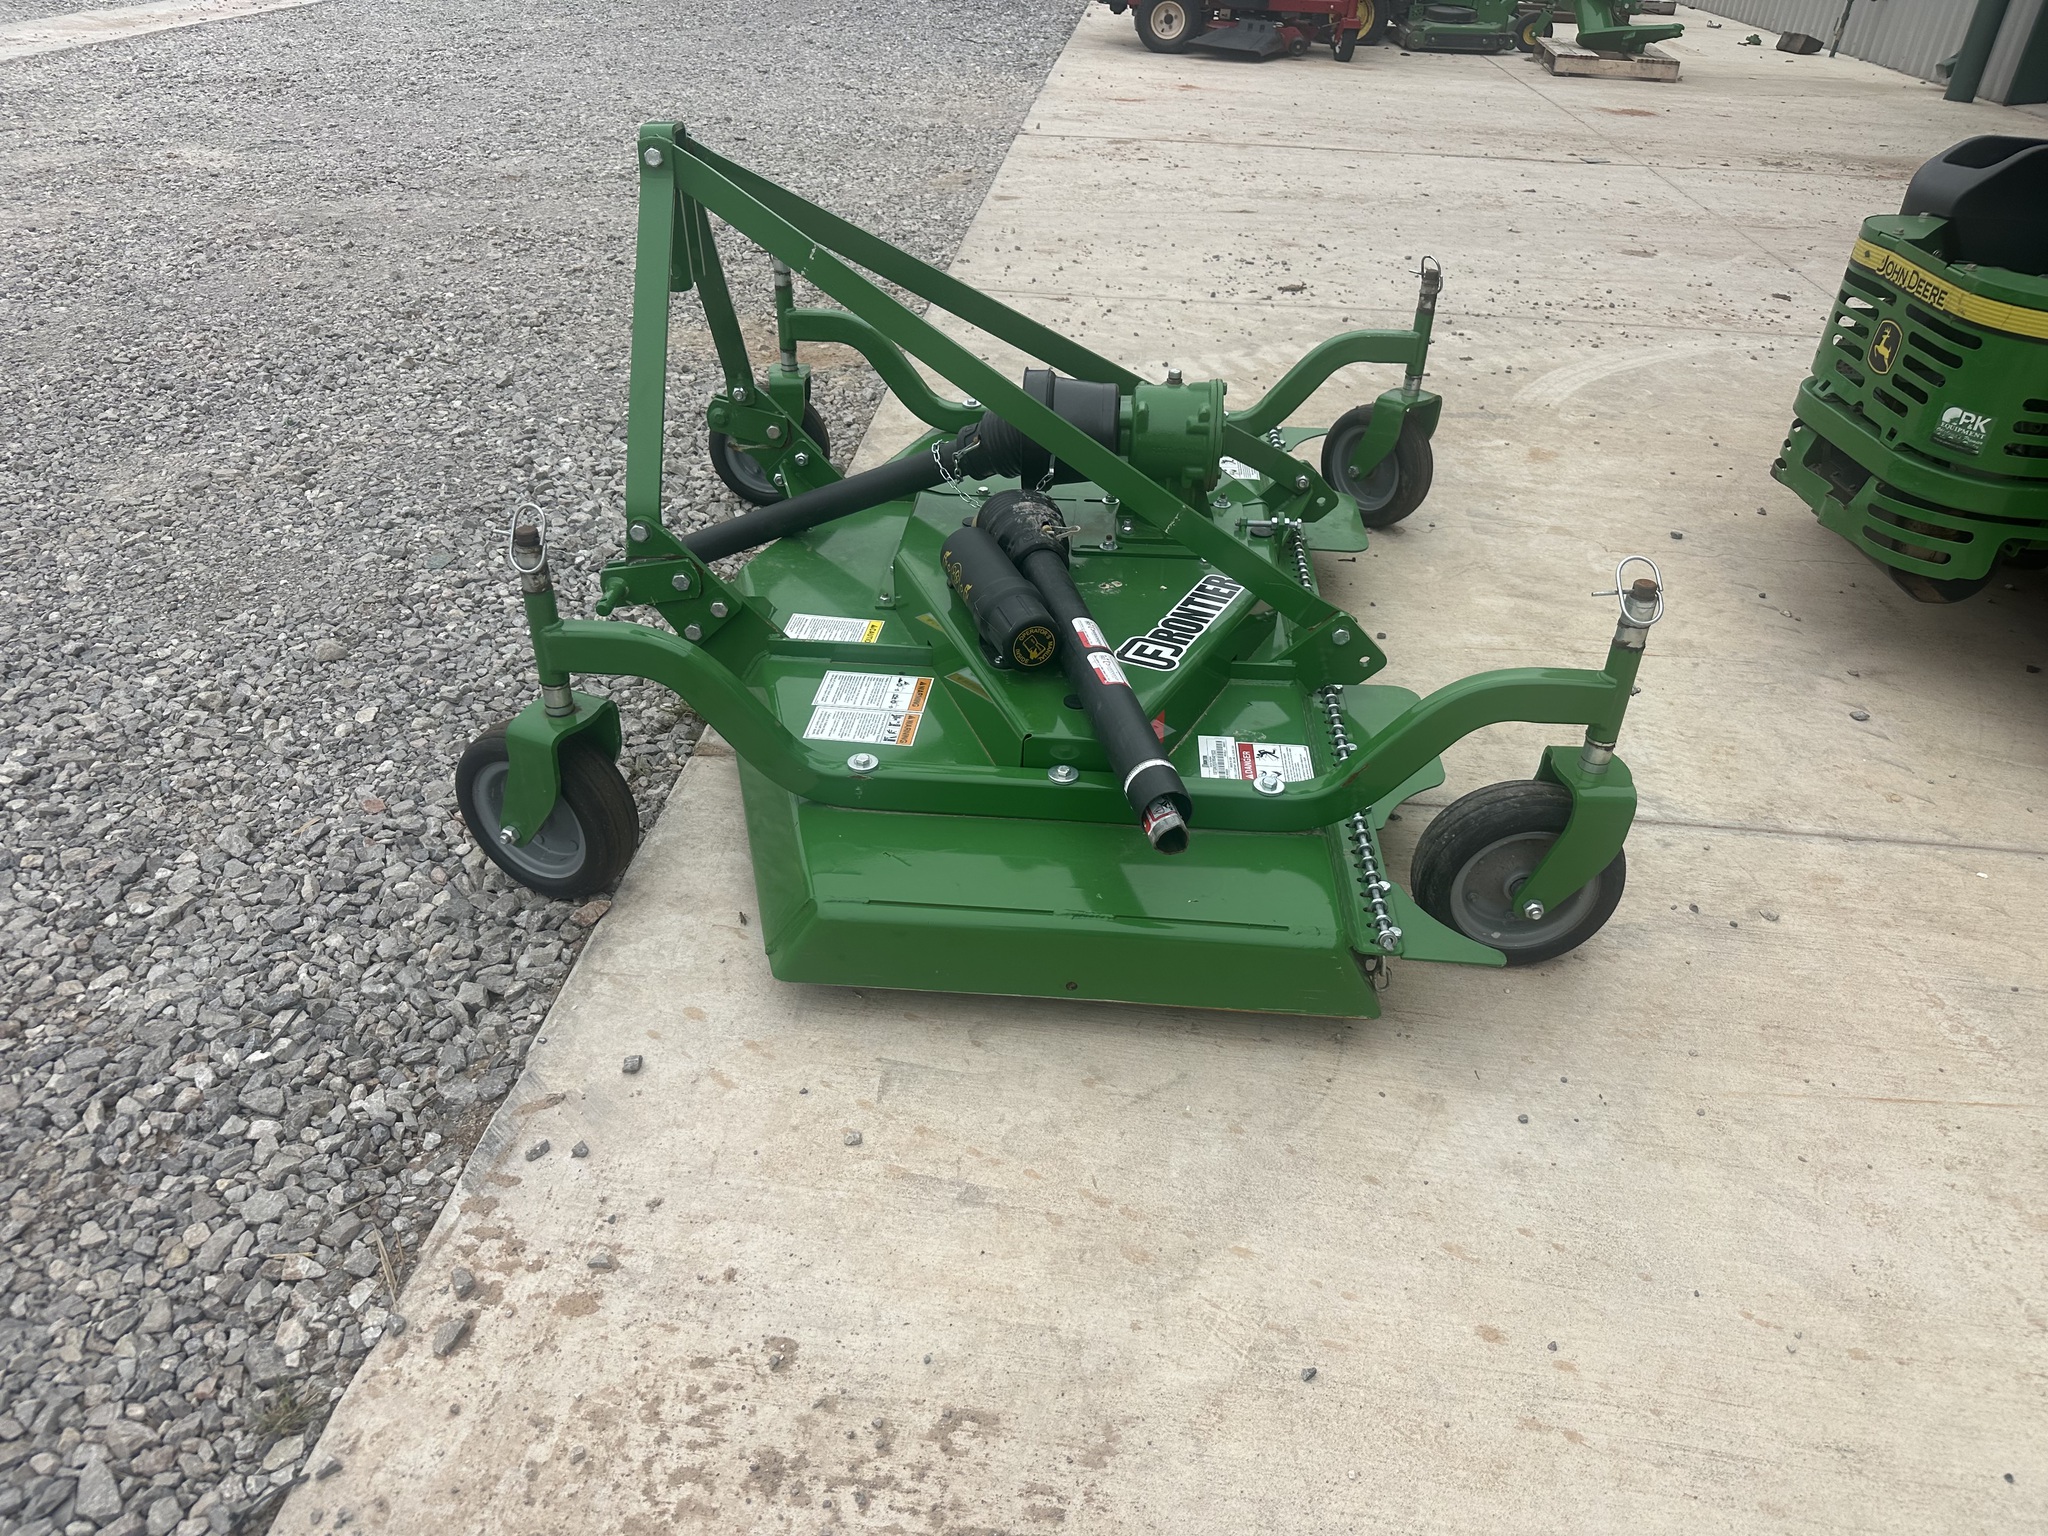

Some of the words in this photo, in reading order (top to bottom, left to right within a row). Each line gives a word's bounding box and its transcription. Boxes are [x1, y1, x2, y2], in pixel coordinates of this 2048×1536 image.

[1876, 255, 1909, 288] JOHN
[1907, 270, 1948, 308] DEERE
[1940, 421, 1986, 440] EQUIPMENT
[1115, 574, 1243, 671] FRONTIER
[912, 685, 925, 708] WARNING
[900, 719, 913, 744] WARNING
[1242, 750, 1255, 774] DANGER
